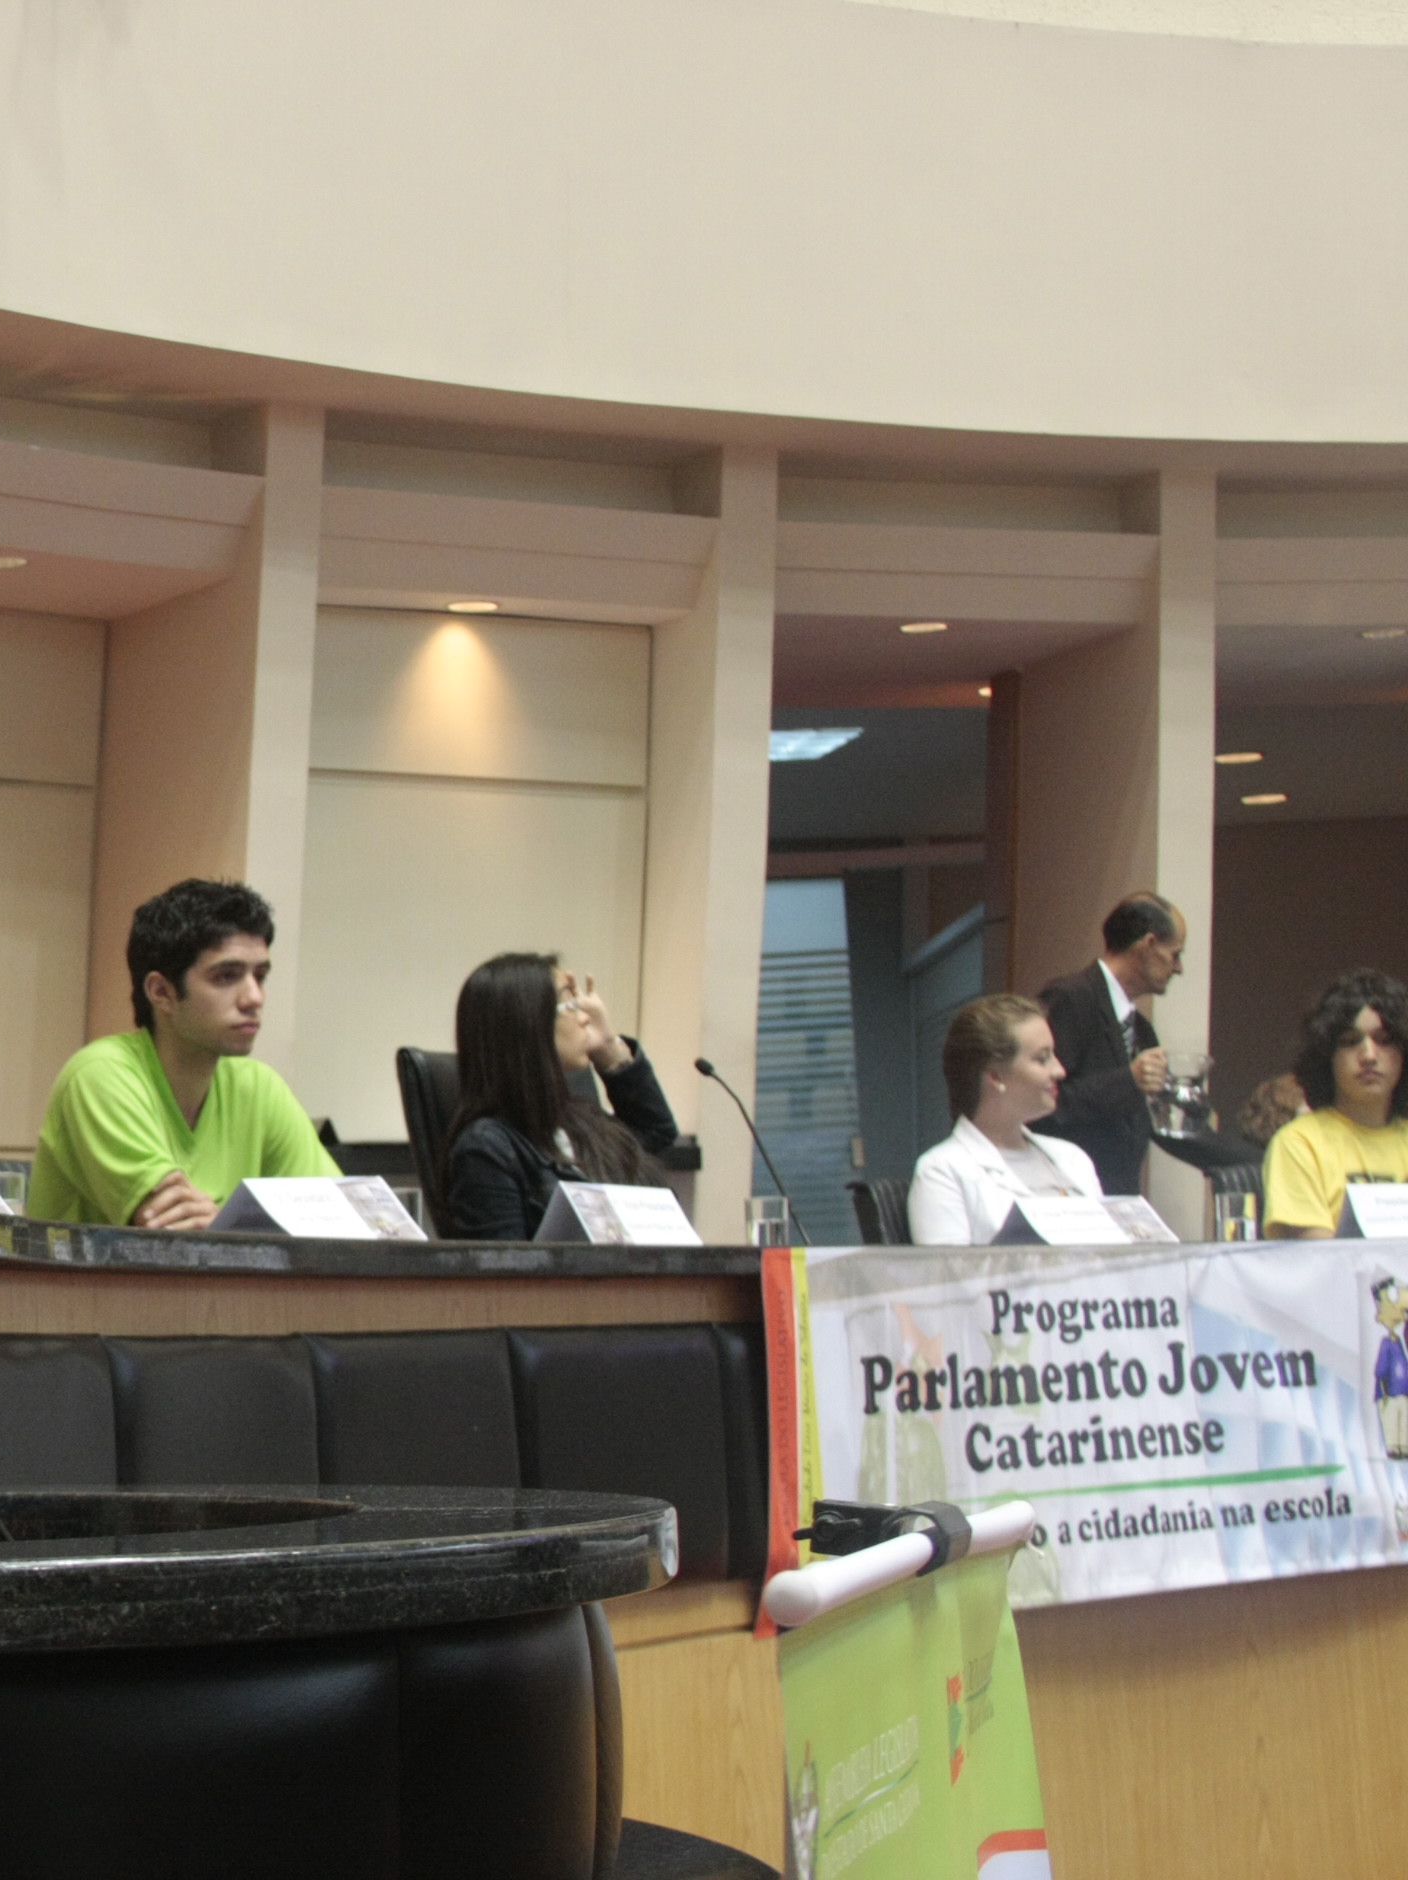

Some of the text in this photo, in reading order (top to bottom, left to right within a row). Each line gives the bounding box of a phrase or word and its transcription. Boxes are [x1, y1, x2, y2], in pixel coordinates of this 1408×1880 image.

[989, 1289, 1179, 1343] Programa
[860, 1341, 1317, 1415] Parlamento Jovem
[964, 1415, 1224, 1473] Catarinense
[1058, 1520, 1072, 1544] a
[1078, 1501, 1214, 1542] cidadania
[1220, 1502, 1255, 1527] na
[1264, 1488, 1352, 1523] escola
